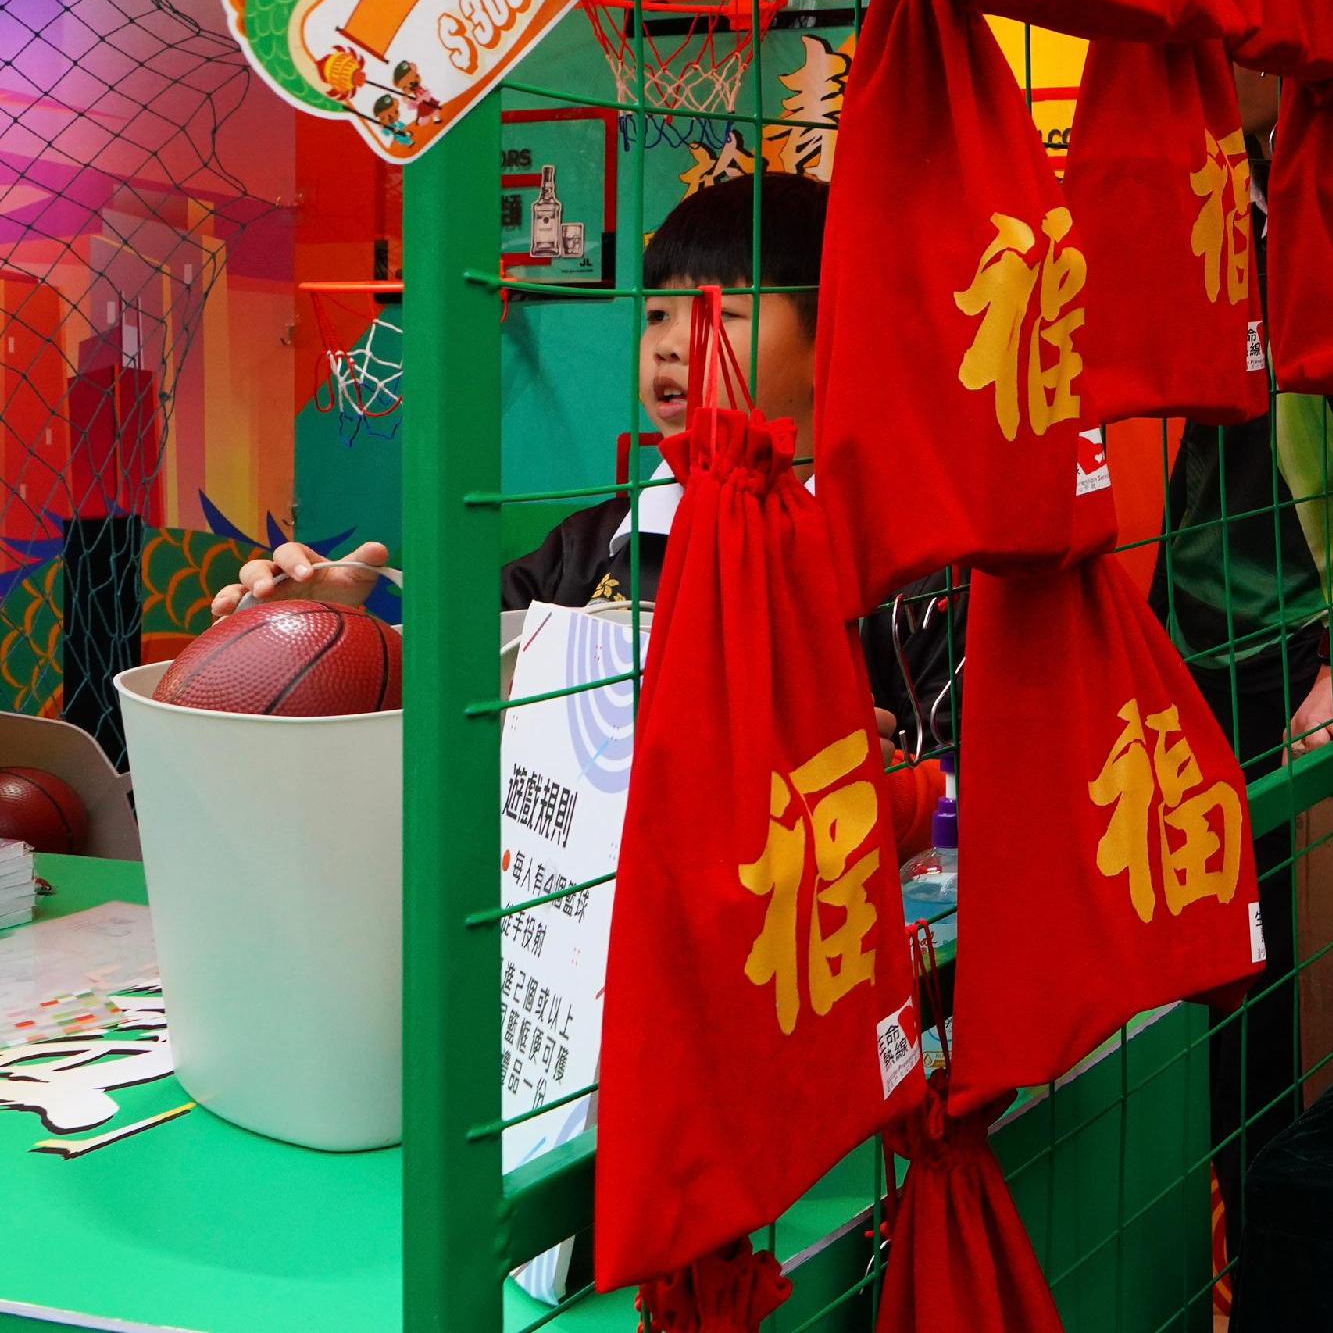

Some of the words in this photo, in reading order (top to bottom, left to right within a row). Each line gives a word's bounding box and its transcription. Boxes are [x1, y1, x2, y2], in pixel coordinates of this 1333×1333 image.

[953, 205, 1088, 442] 福
[501, 762, 579, 848] 遊戲規則
[738, 729, 881, 1036] 福
[1087, 698, 1244, 925] 福
[500, 957, 574, 1040] 進2個或以上
